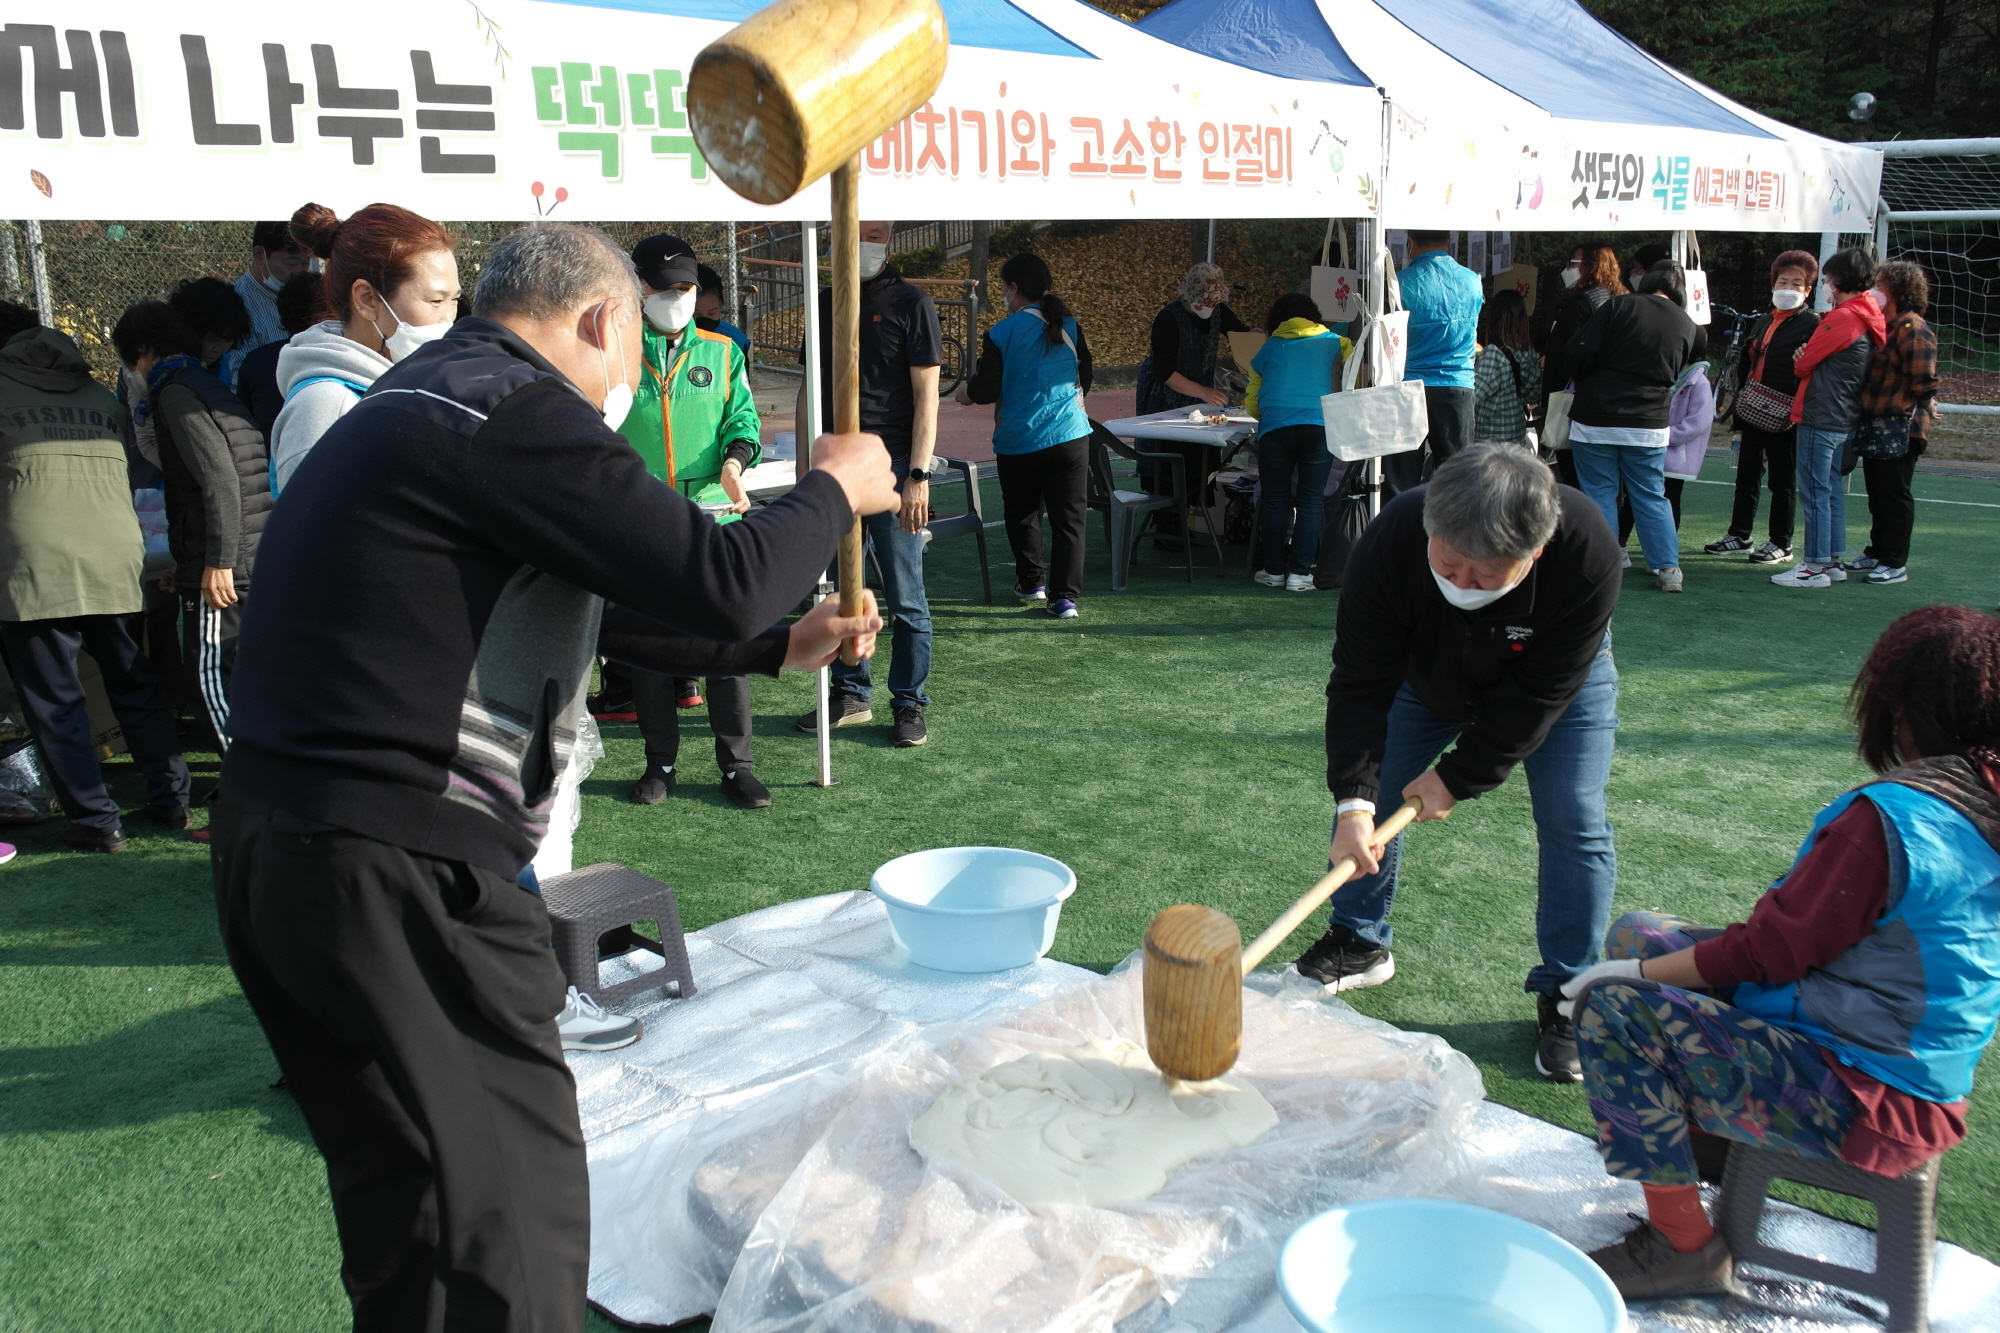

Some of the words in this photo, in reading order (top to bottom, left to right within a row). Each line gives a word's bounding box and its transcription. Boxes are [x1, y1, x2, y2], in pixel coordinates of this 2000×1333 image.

[180, 34, 496, 174] 나누는
[1069, 116, 1187, 180] 고소한
[1199, 122, 1293, 182] 인절미
[1570, 150, 1644, 210] 샛터의
[1651, 155, 1690, 211] 식물
[1694, 166, 1740, 207] 에코백
[1744, 170, 1786, 209] 만들기
[11, 407, 117, 434] FISHION
